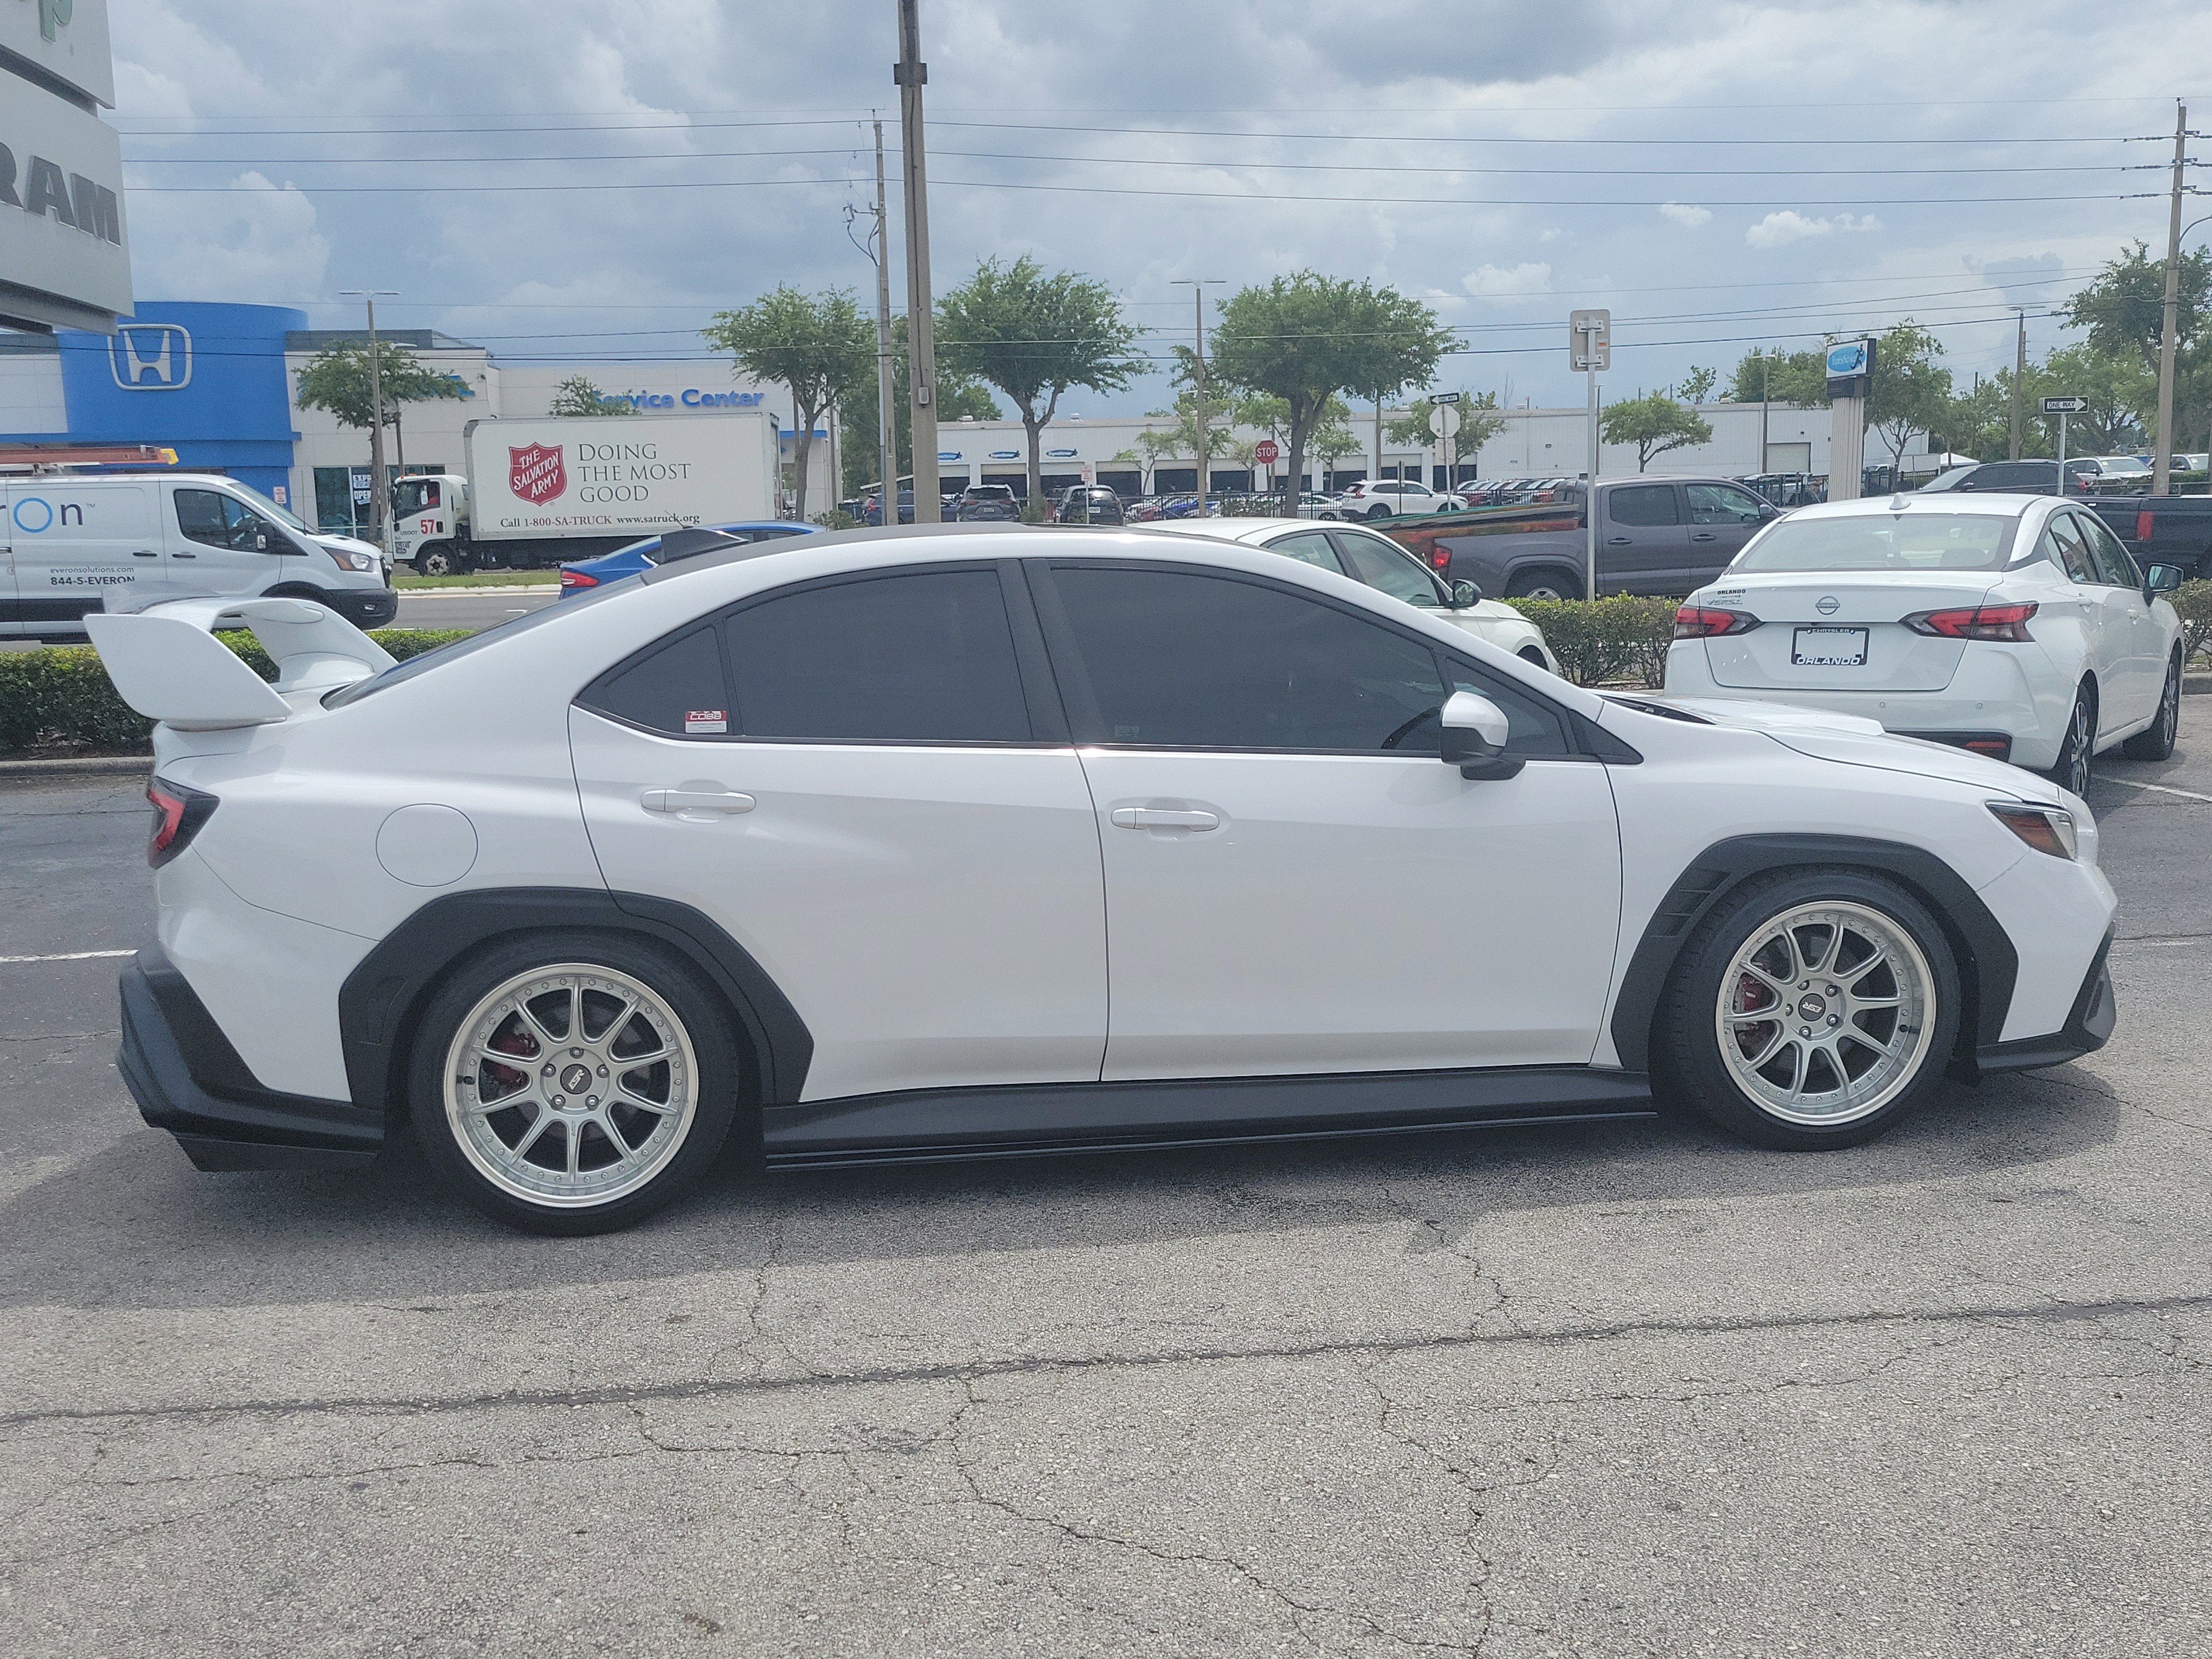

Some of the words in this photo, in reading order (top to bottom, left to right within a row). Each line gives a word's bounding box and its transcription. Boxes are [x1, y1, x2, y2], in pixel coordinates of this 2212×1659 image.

[681, 389, 764, 407] Center
[520, 449, 540, 469] THE
[578, 443, 657, 461] DOING
[1257, 447, 1277, 457] STOP
[514, 452, 559, 490] SALVATION
[578, 465, 622, 482] THE
[631, 464, 691, 481] MOST
[531, 469, 558, 498] ARMY
[580, 486, 648, 503] GOOD
[420, 519, 435, 534] 57
[500, 518, 520, 527] Call
[524, 516, 613, 527] 1-800-SA-TRUCK
[617, 513, 700, 524] www.satruck.org
[50, 576, 135, 585] 844-5-EVERON
